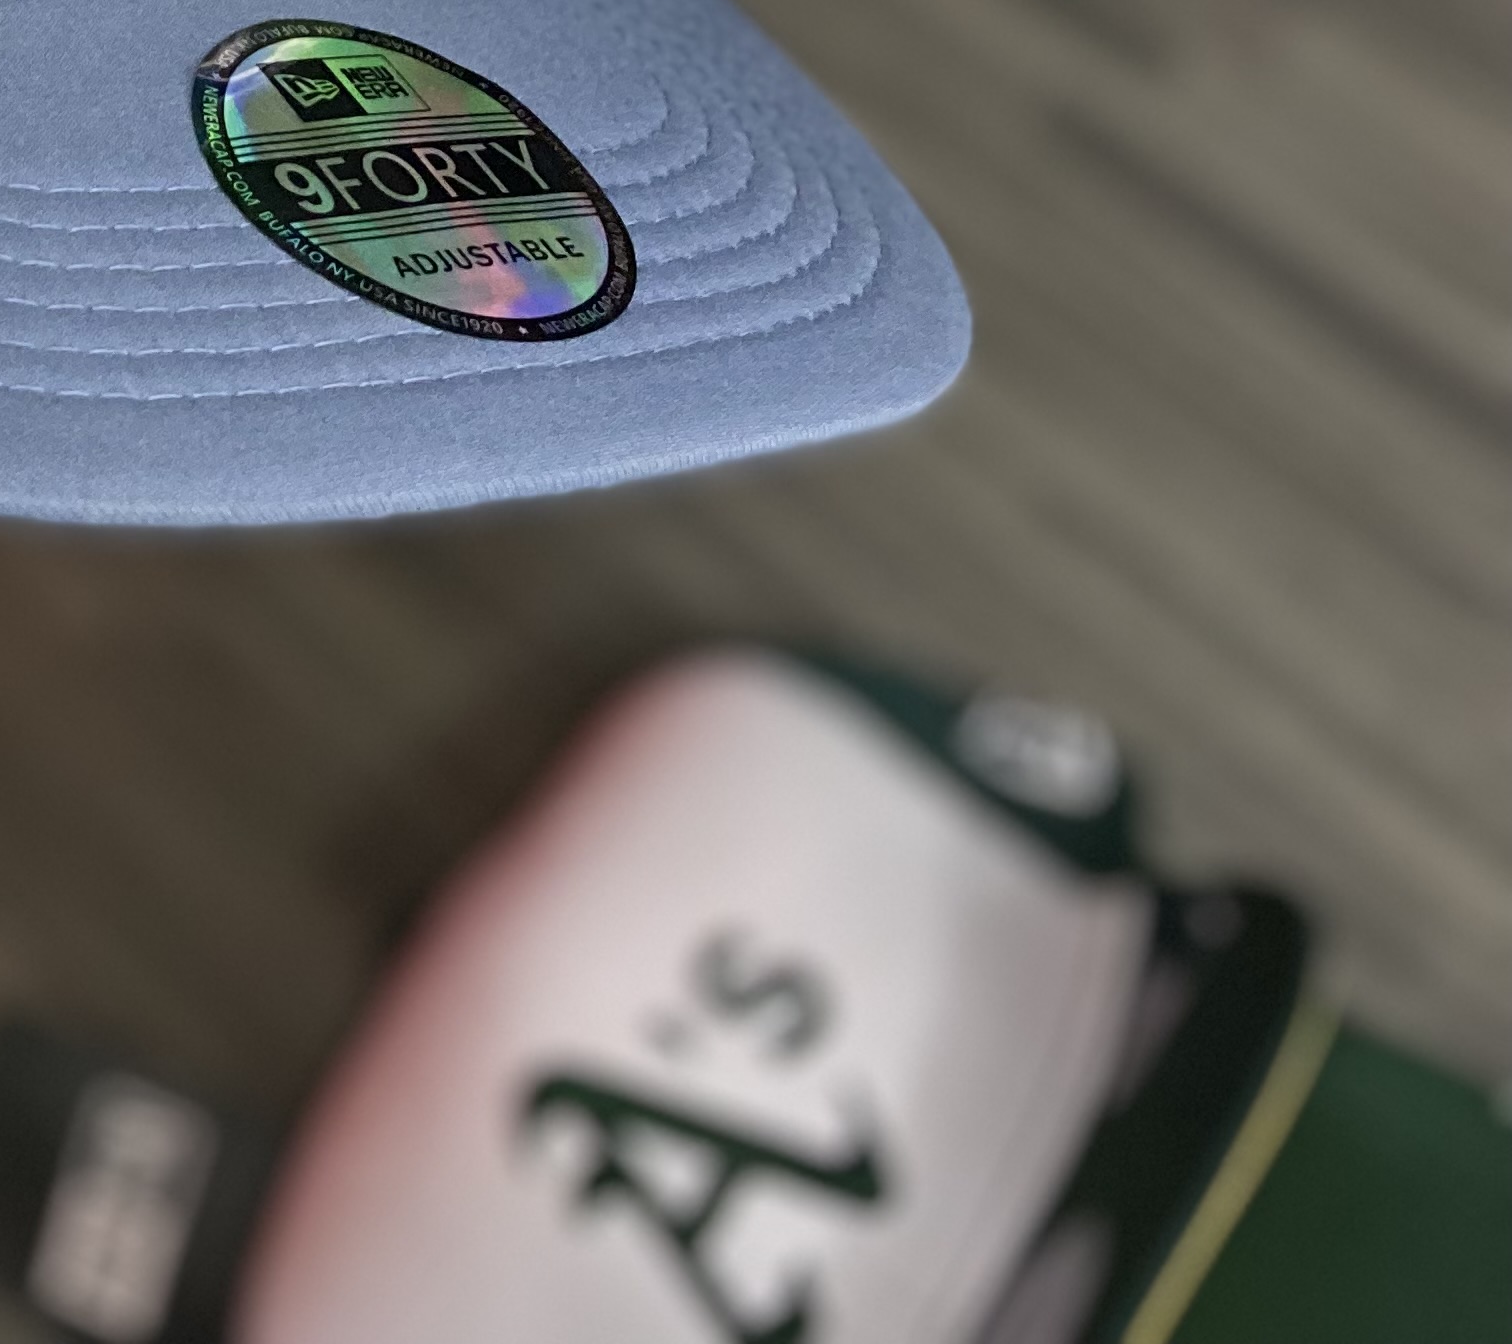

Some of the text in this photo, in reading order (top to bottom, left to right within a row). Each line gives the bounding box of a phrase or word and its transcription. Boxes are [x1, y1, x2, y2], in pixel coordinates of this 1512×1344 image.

[339, 65, 395, 82] NEW
[354, 80, 410, 100] ERA
[202, 85, 261, 207] NEWERACAP.COM
[327, 262, 356, 282] NY
[359, 279, 398, 306] USA
[274, 139, 550, 214] 9FORTY
[393, 235, 586, 278] ADJUSTABLE
